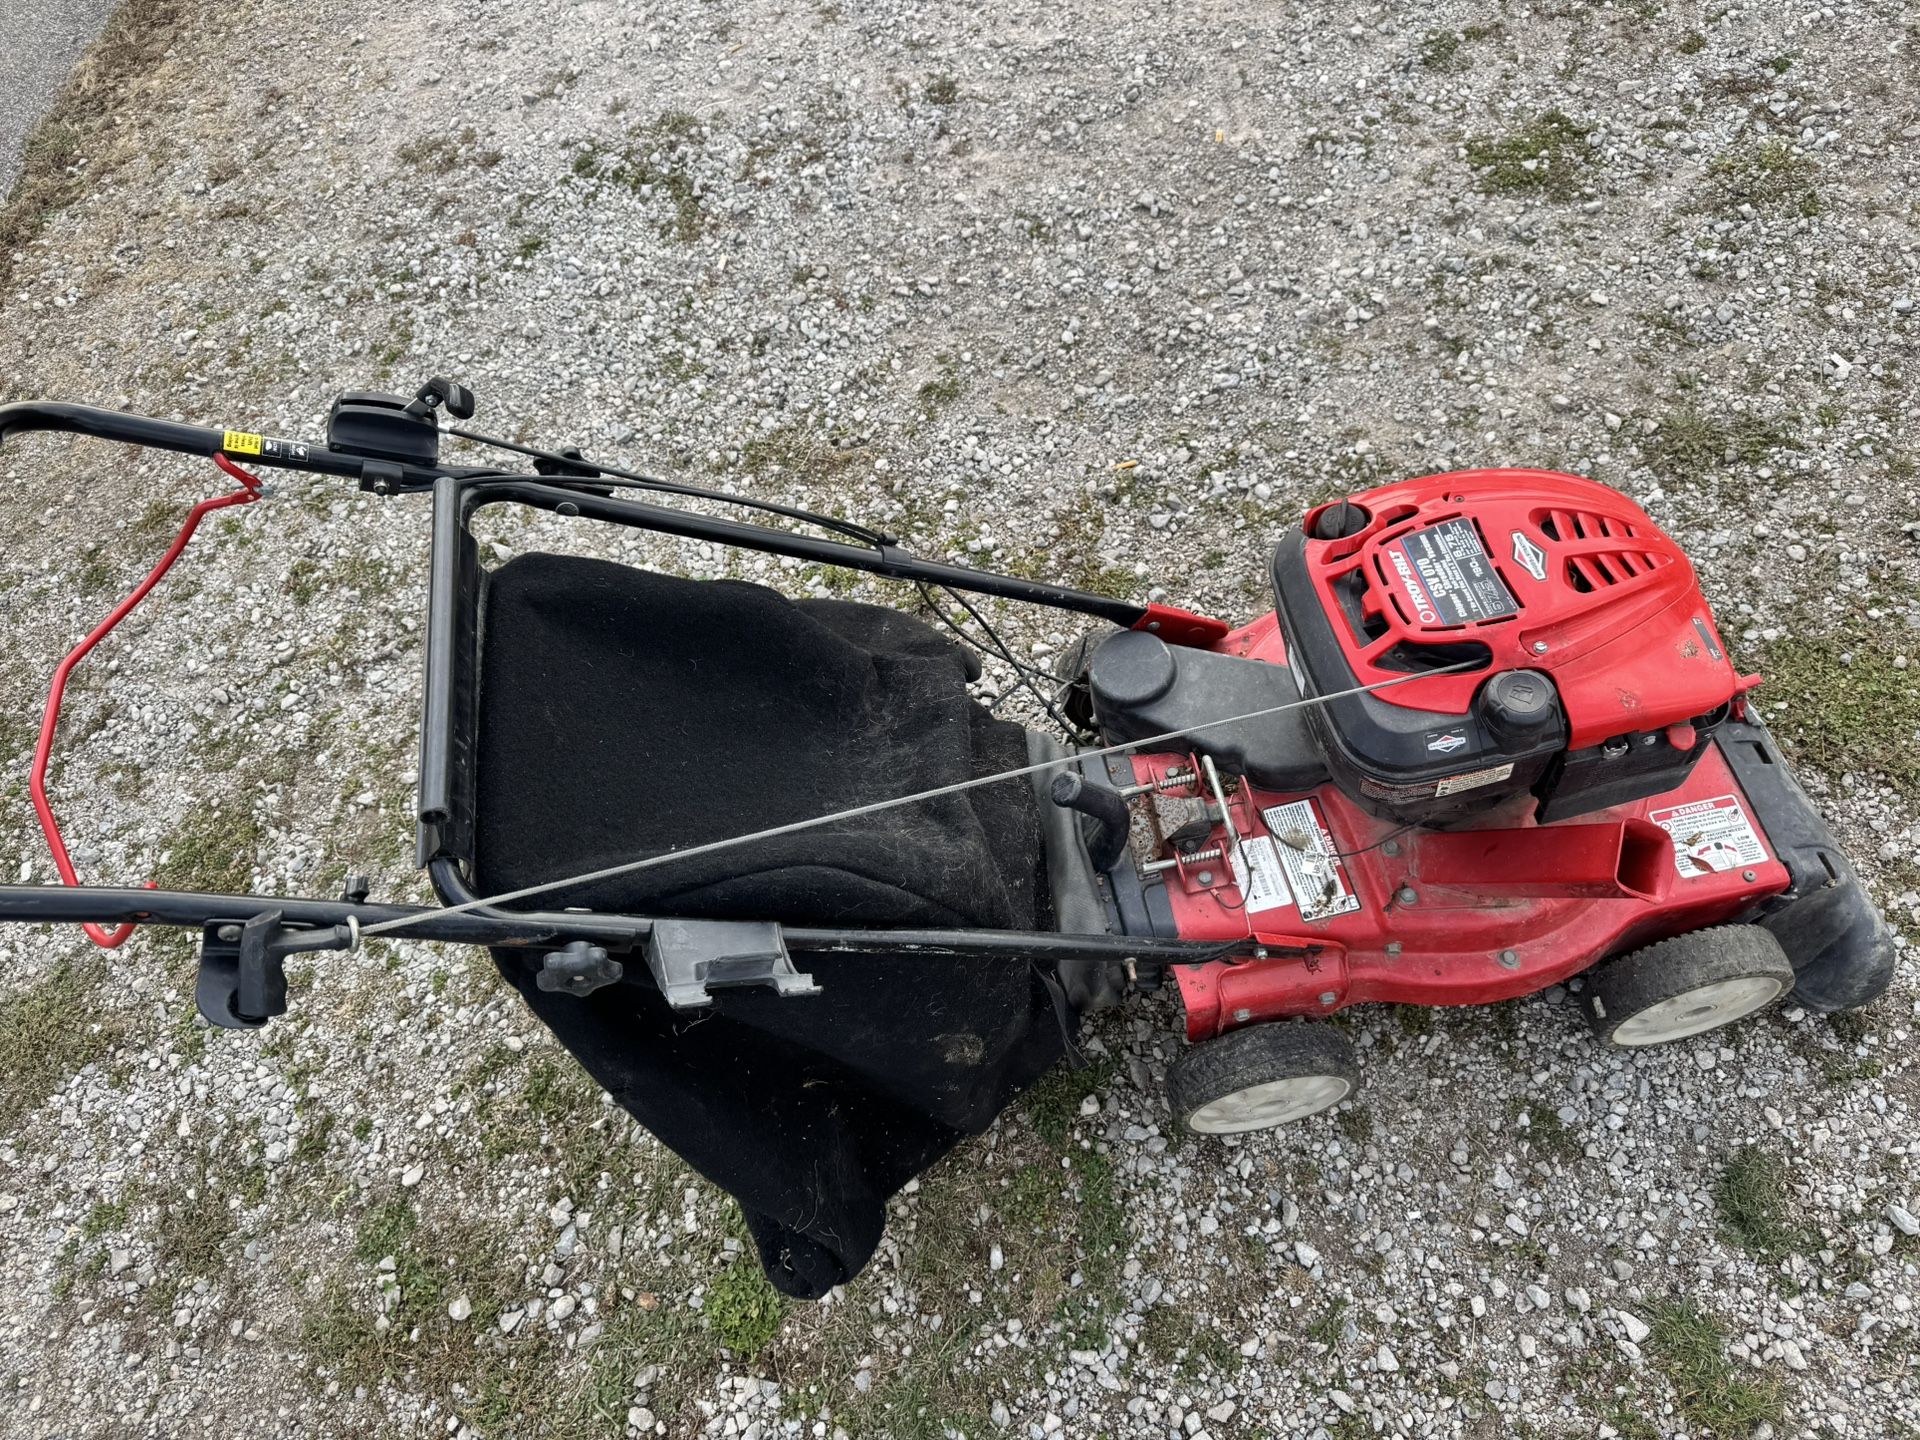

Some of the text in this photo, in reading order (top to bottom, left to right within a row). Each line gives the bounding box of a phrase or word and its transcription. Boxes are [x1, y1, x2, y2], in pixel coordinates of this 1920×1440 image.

[1444, 533, 1463, 558] 8.75
[1388, 549, 1429, 612] TROY-BILT
[1416, 557, 1447, 598] CSV 070
[1419, 534, 1468, 618] Chipper Shredder Vacuum
[1679, 803, 1715, 815] DANGER
